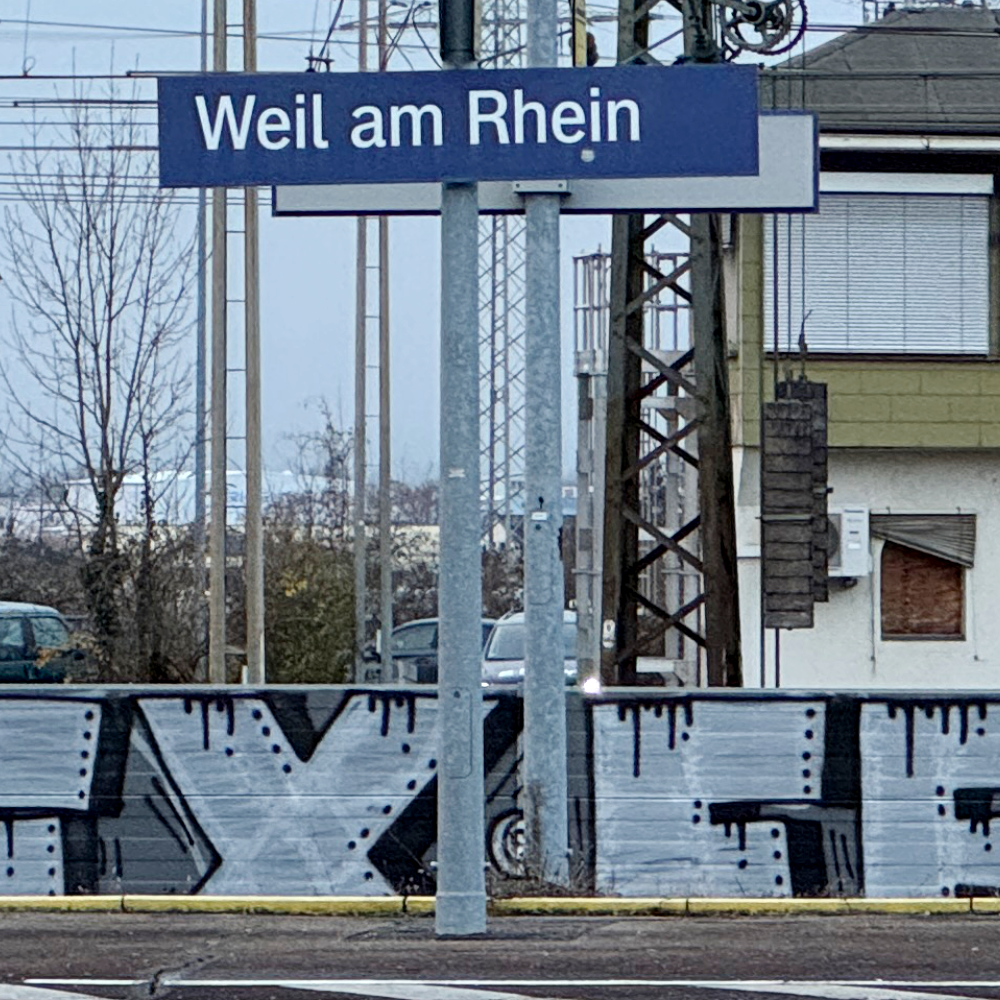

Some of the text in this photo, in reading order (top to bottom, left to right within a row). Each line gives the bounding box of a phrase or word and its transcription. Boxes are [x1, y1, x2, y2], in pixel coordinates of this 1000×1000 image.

[194, 87, 640, 150] Weil am Rhein
